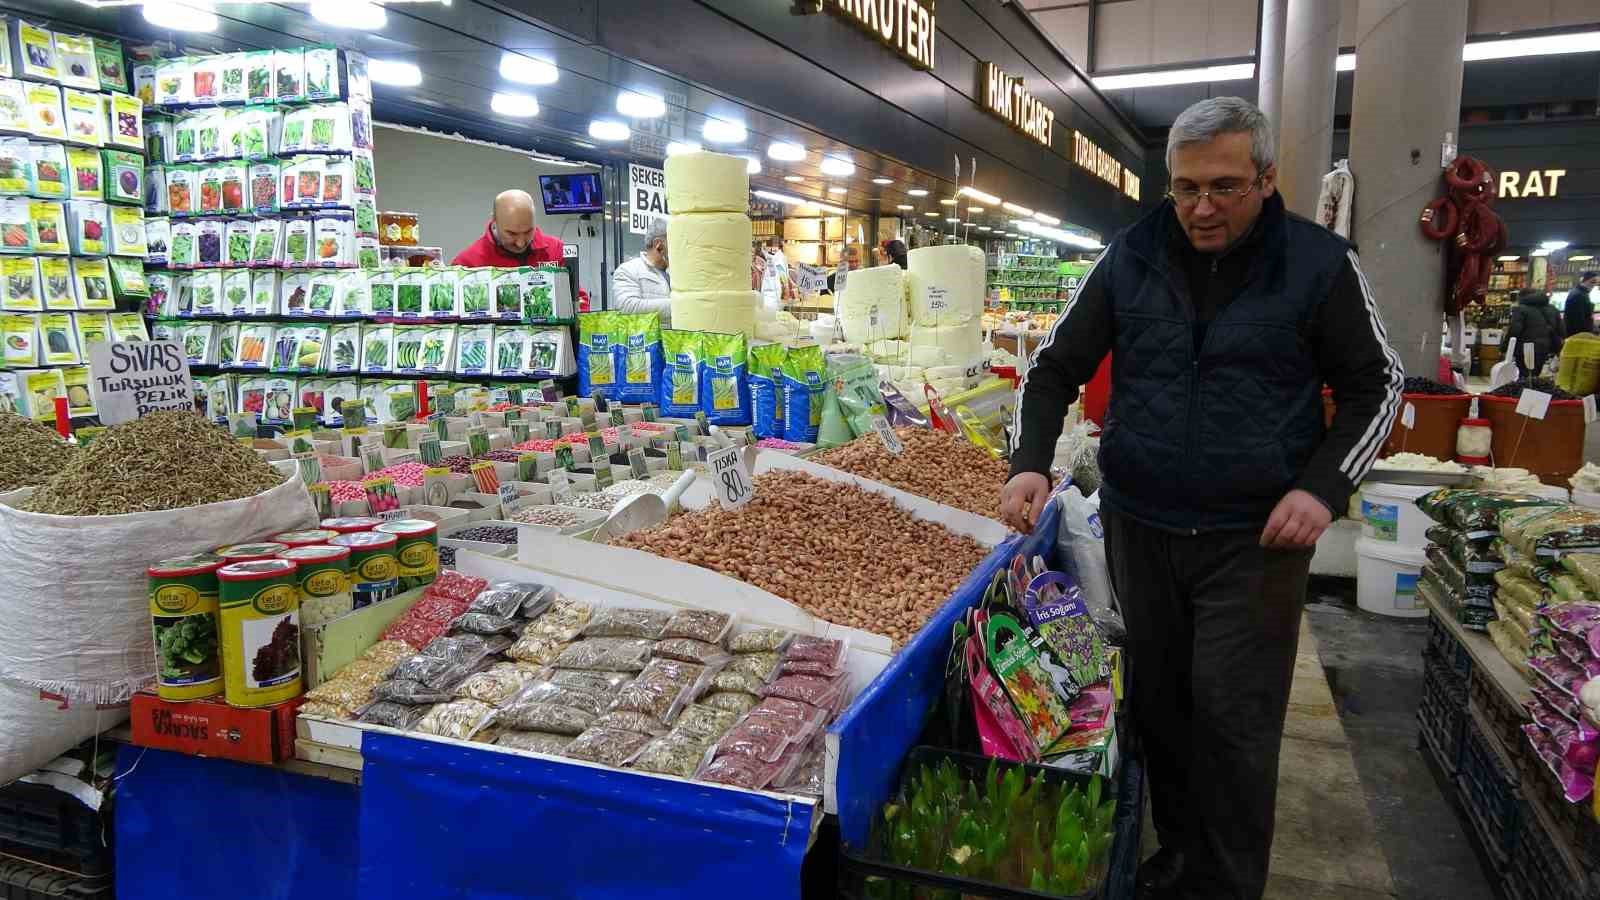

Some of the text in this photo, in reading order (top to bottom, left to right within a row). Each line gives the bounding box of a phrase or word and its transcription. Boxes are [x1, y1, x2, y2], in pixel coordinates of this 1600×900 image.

[988, 62, 1012, 121] HAK
[1498, 169, 1567, 198] RAT
[721, 468, 745, 503] 80
